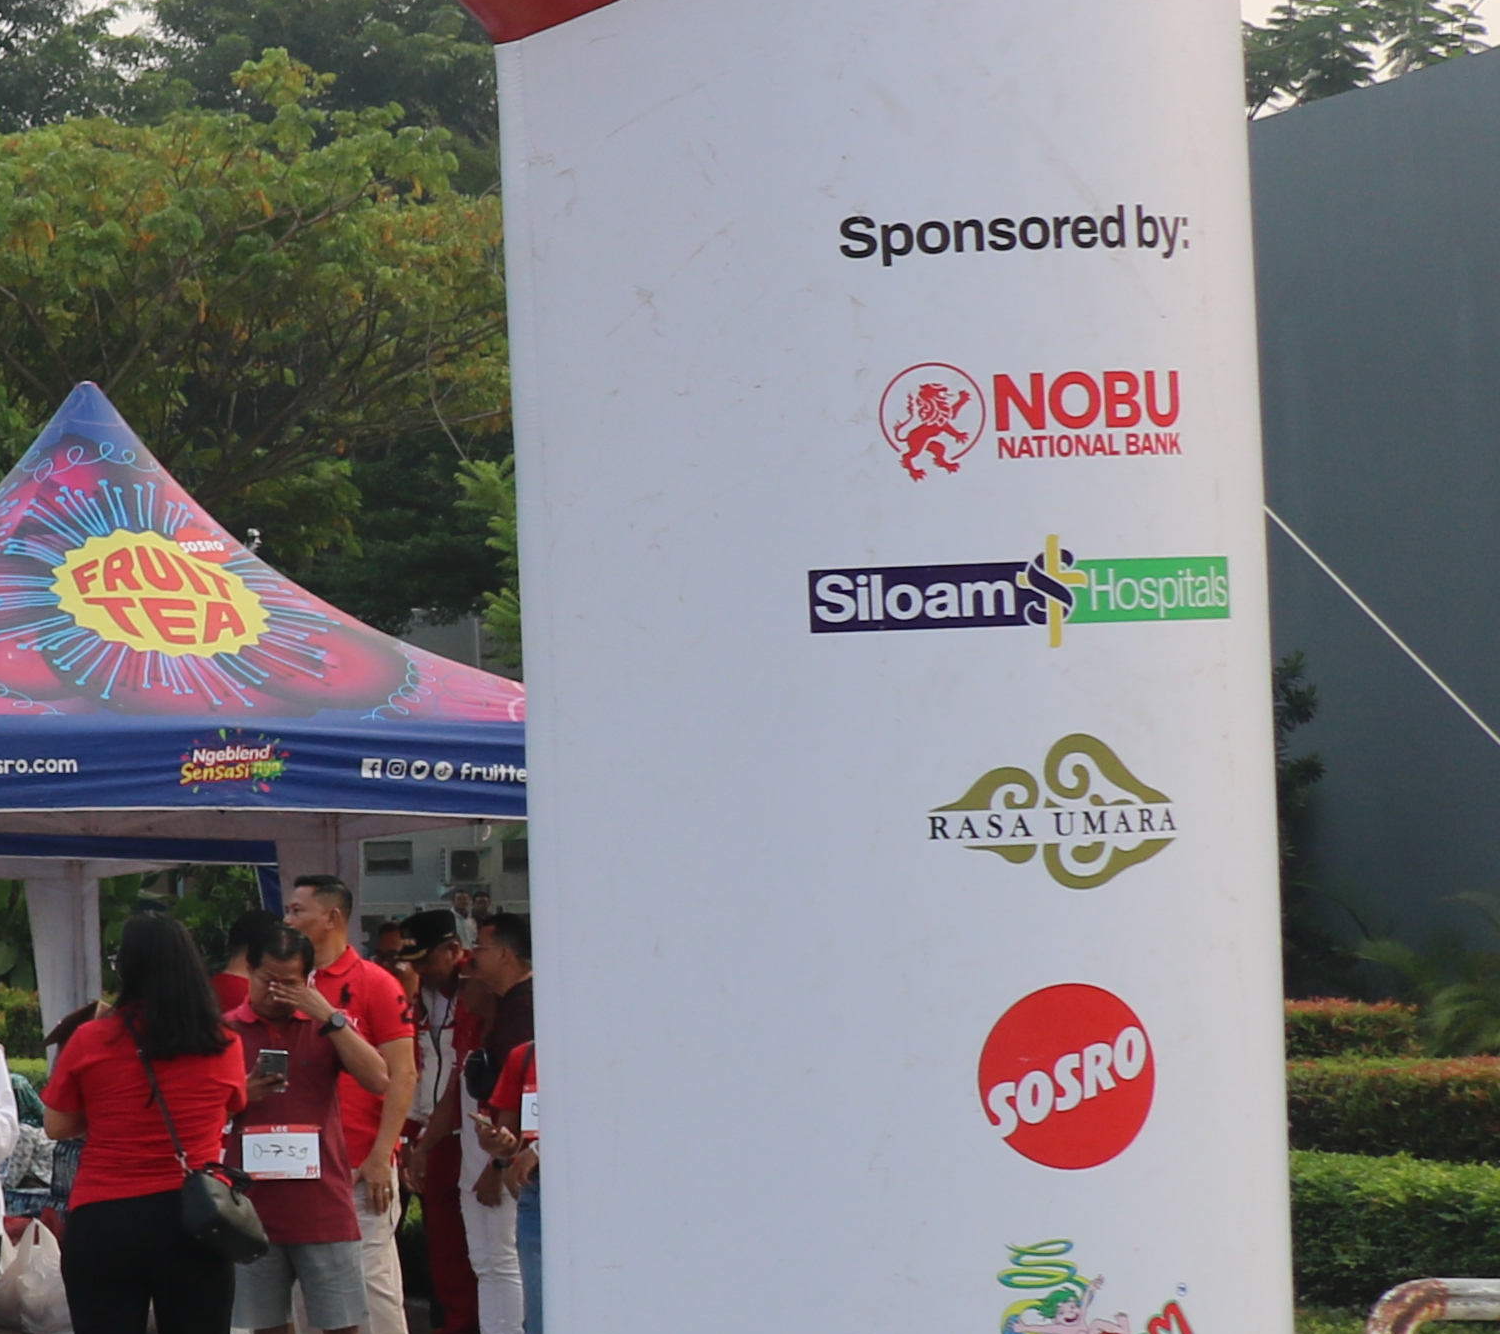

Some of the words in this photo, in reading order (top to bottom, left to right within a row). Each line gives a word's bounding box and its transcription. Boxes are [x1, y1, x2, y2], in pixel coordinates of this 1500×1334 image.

[838, 204, 1126, 267] Sponsored
[1135, 204, 1190, 259] by:
[992, 370, 1181, 432] NOBU
[997, 433, 1121, 460] NATIONAL
[1125, 432, 1182, 456] BANK
[179, 540, 225, 554] SOSRO
[71, 545, 231, 601] FRUIT
[813, 573, 1016, 625] Siloam
[1090, 566, 1228, 619] Hospitals
[82, 596, 247, 645] TEA
[179, 762, 250, 785] Sensasi
[192, 744, 271, 766] Ngeblend
[928, 813, 1033, 841] RASA
[1053, 807, 1178, 837] UMARA
[987, 1025, 1147, 1139] SOSRO
